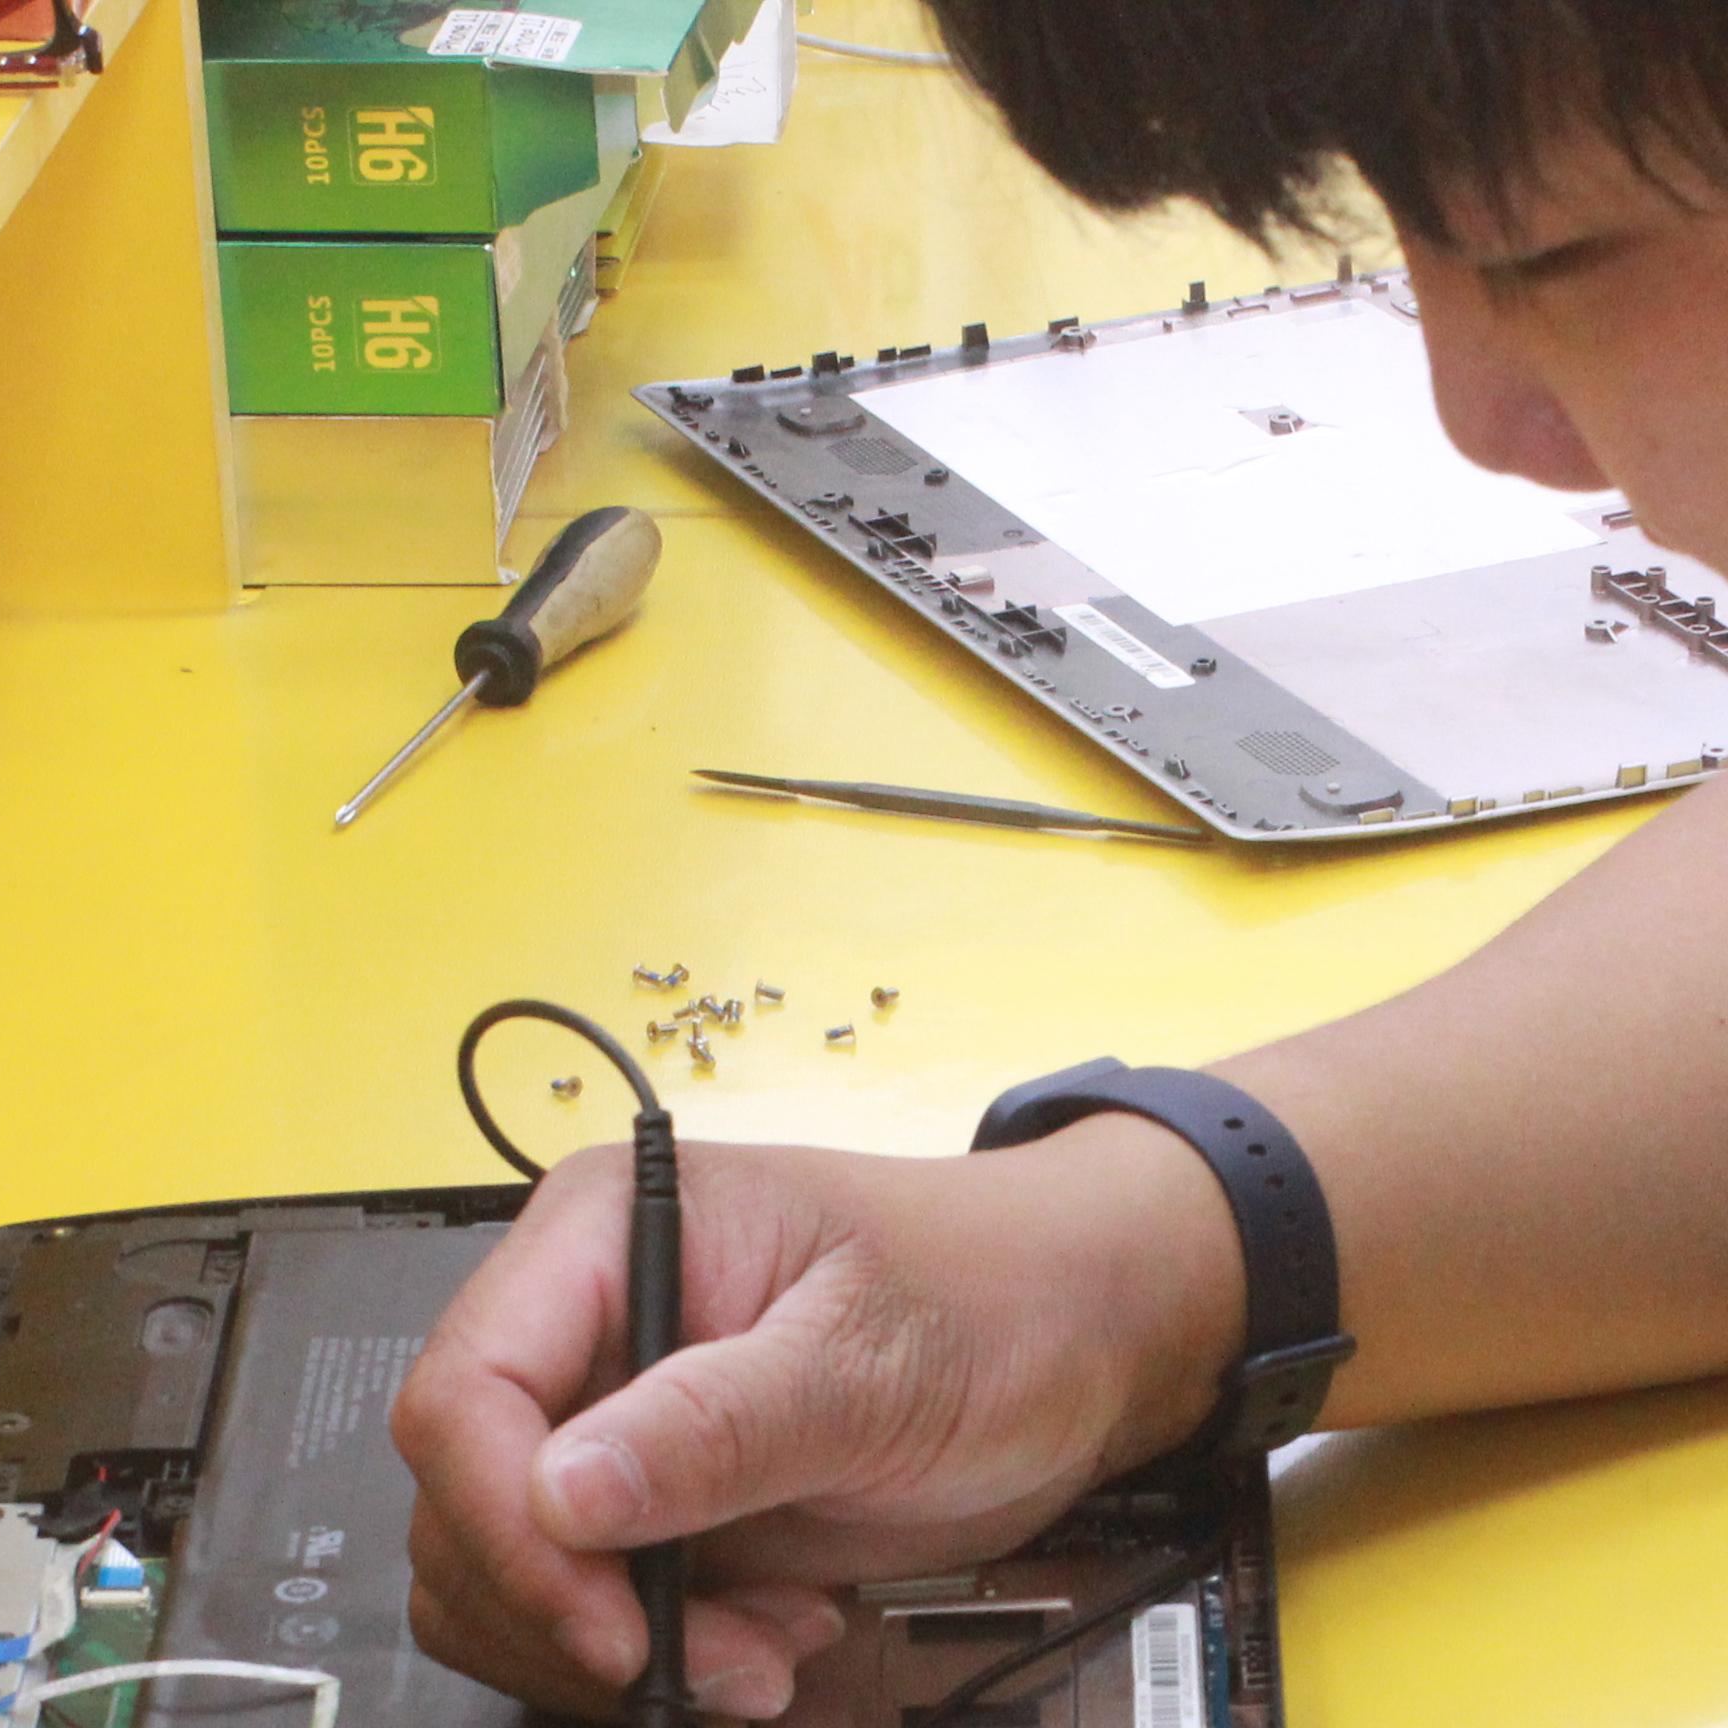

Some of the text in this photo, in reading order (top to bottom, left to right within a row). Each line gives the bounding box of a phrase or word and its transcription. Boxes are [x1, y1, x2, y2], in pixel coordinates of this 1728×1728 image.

[303, 105, 330, 185] 10PCS
[357, 106, 433, 182] 9H
[308, 295, 335, 373] 10PCS
[362, 296, 438, 369] 9H
